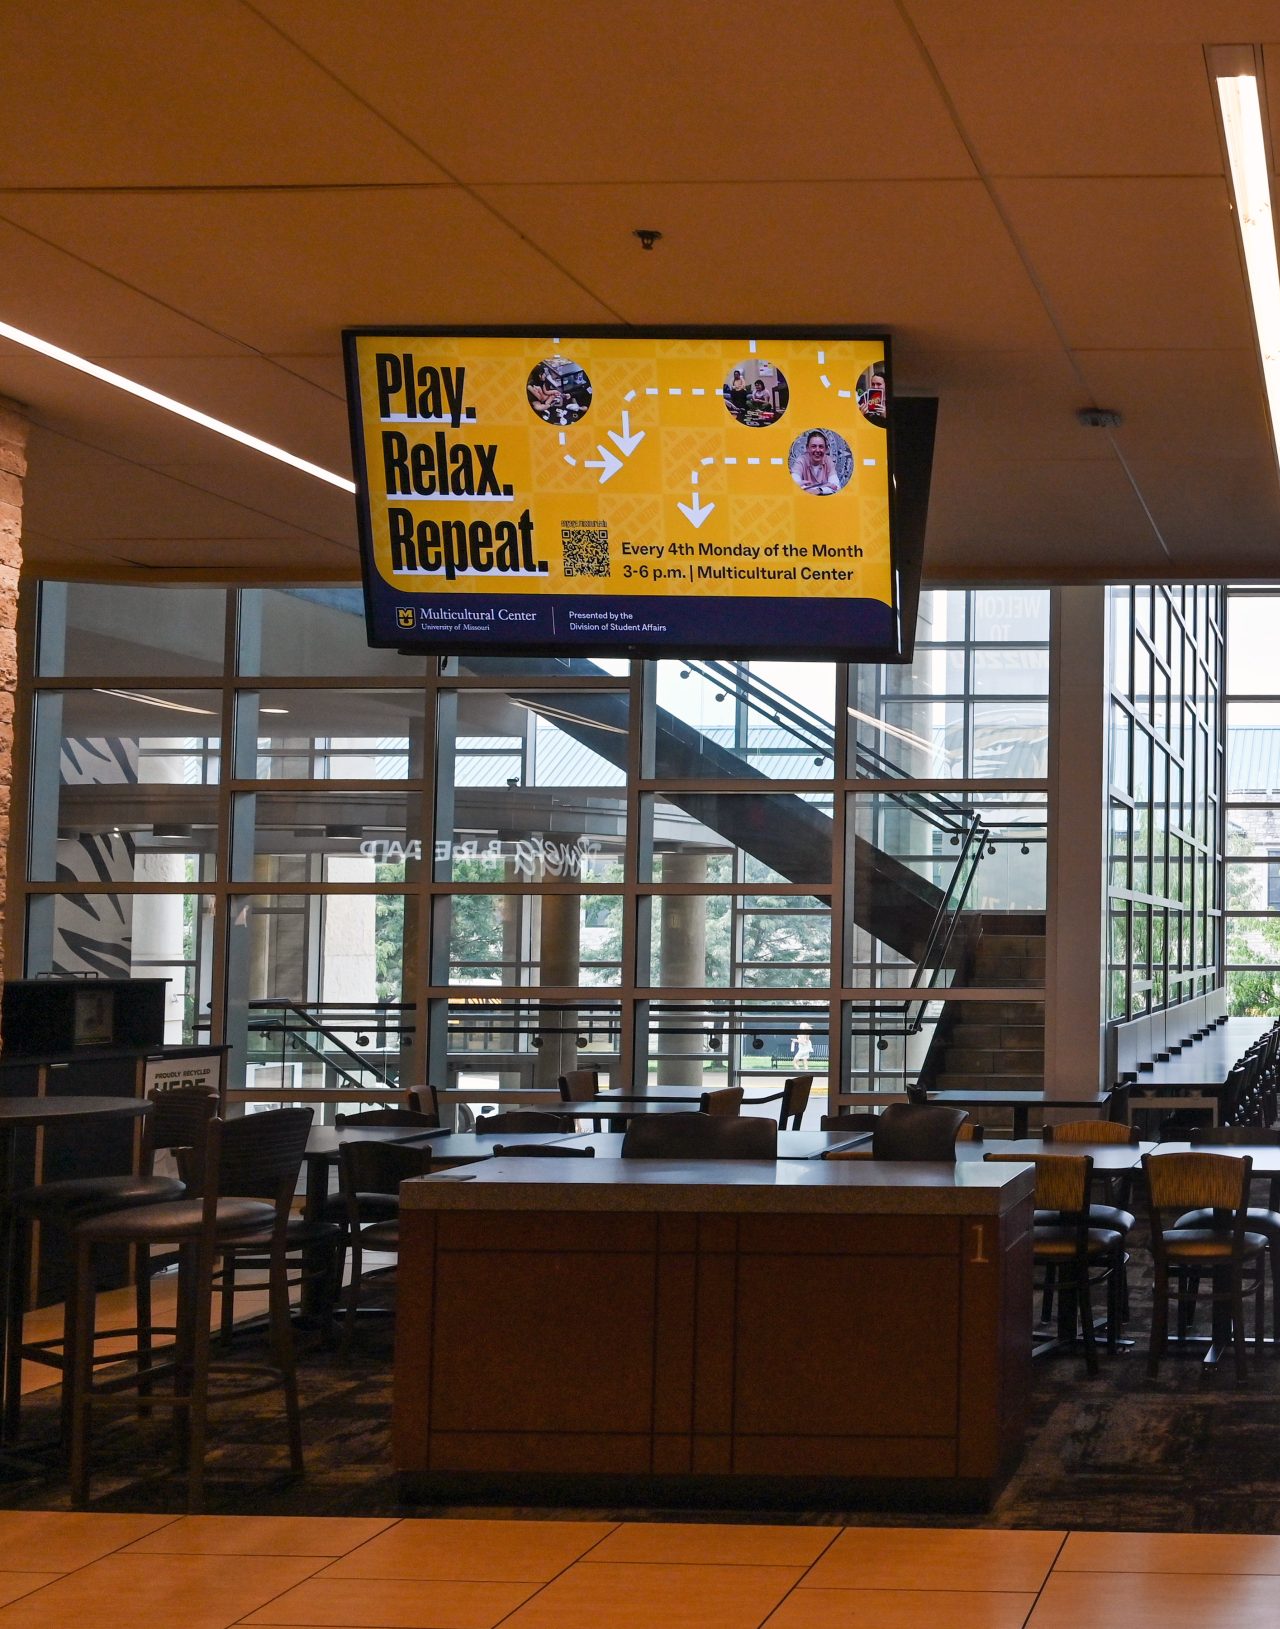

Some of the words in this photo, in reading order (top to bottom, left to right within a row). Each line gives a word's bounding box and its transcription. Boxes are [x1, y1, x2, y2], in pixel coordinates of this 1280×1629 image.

[376, 353, 476, 428] Play.
[381, 431, 513, 496] Relax.
[388, 508, 549, 580] Repeat.
[621, 541, 664, 558] Every
[668, 541, 694, 556] 4th
[698, 542, 760, 559] Monday
[764, 542, 779, 558] of
[782, 543, 808, 558] the
[812, 543, 863, 559] Month
[623, 565, 649, 579] 3-6
[653, 567, 686, 582] p.m.
[697, 566, 797, 581] Multicultural
[800, 567, 854, 581] Center
[420, 608, 495, 621] Multicultural
[498, 608, 537, 621] Center
[568, 610, 607, 620] Presented
[609, 611, 619, 621] by
[620, 612, 633, 620] the
[421, 623, 453, 632] University
[454, 623, 461, 631] of
[462, 623, 490, 631] Missouri
[569, 622, 599, 631] Division
[601, 623, 609, 631] of
[610, 623, 640, 631] Student
[642, 623, 667, 632] Affairs
[155, 1071, 181, 1079] PROUDLY
[183, 1068, 211, 1077] RECYCLED
